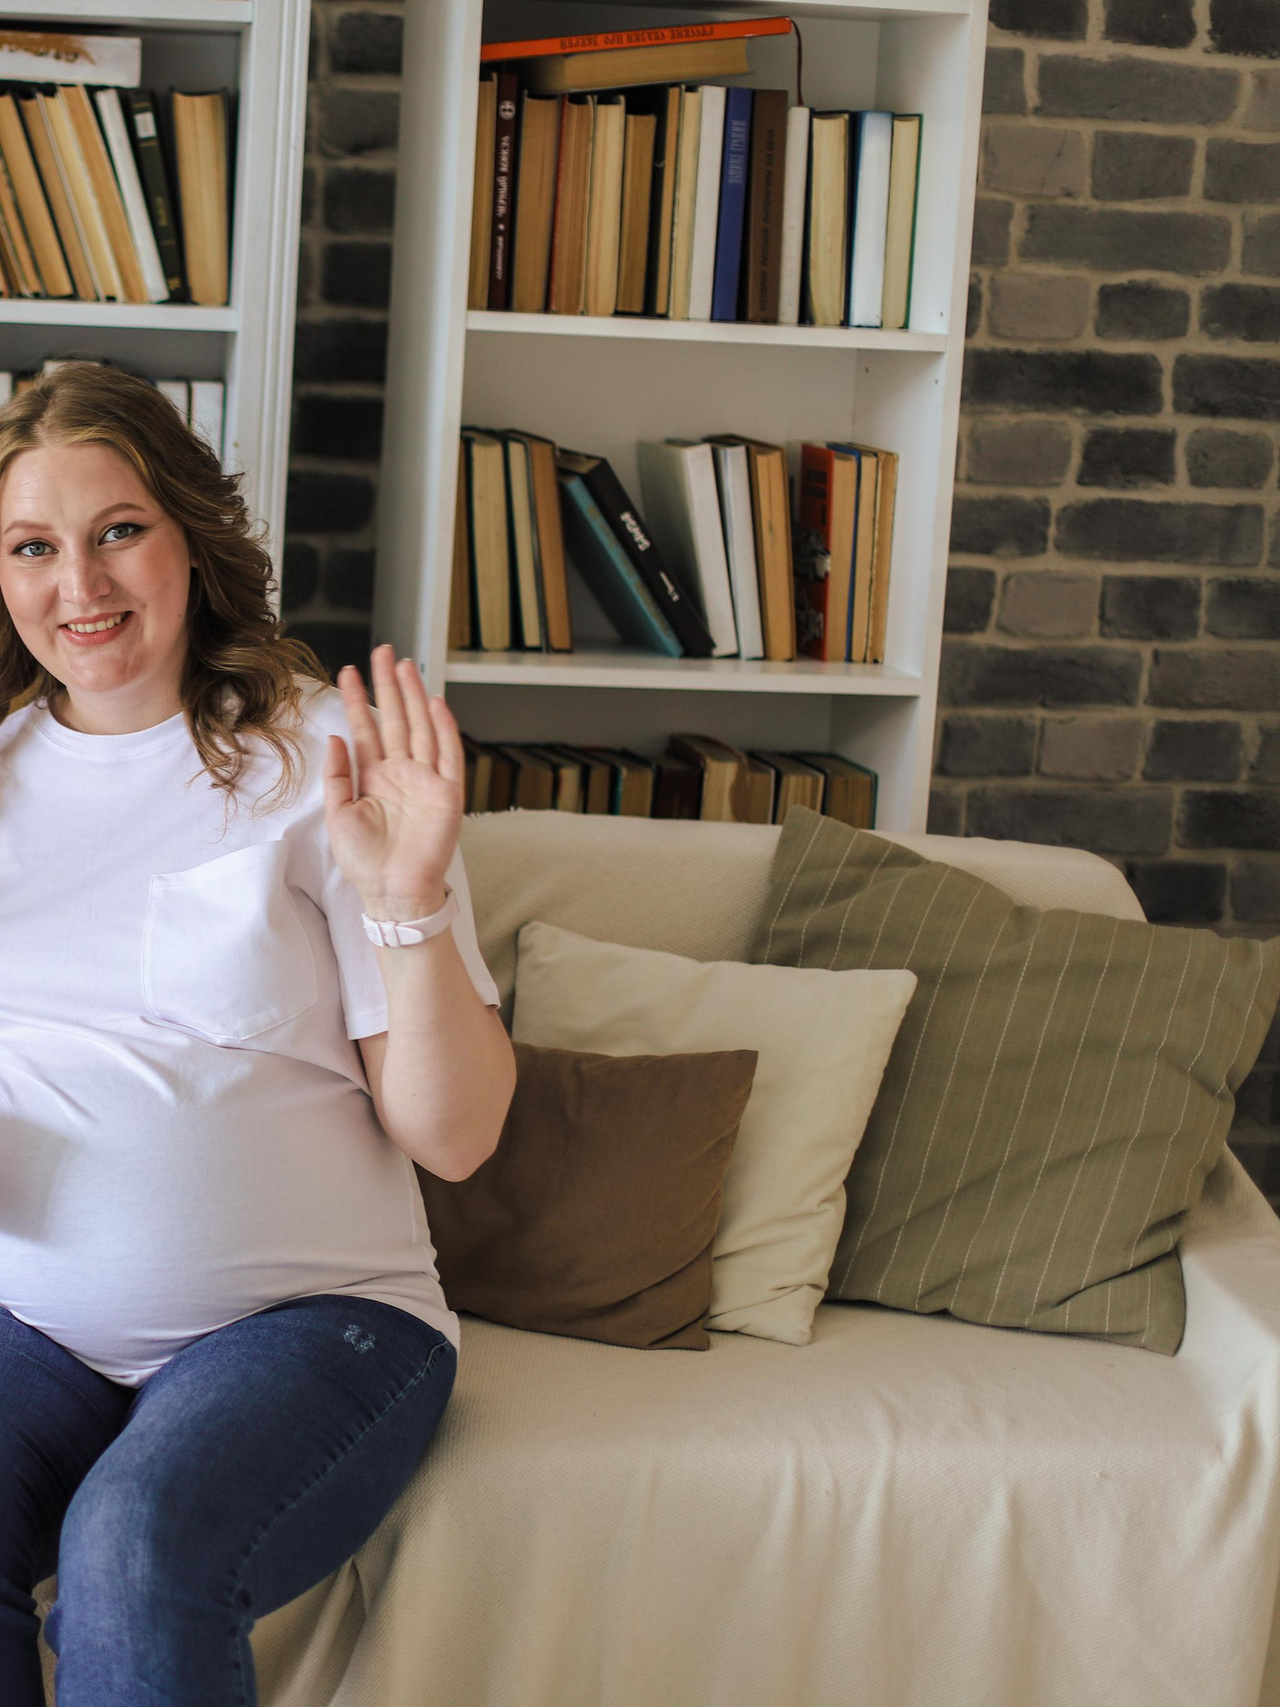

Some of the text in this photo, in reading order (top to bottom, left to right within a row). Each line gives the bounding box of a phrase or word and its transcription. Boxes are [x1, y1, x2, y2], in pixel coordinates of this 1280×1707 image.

[559, 25, 714, 51] РУССКИЕ СКАЗКИ ПРО ЗВЕРЕЙ
[762, 169, 773, 225] ЛИТЕРАТУРЫ
[760, 226, 770, 267] РУССКОЙ
